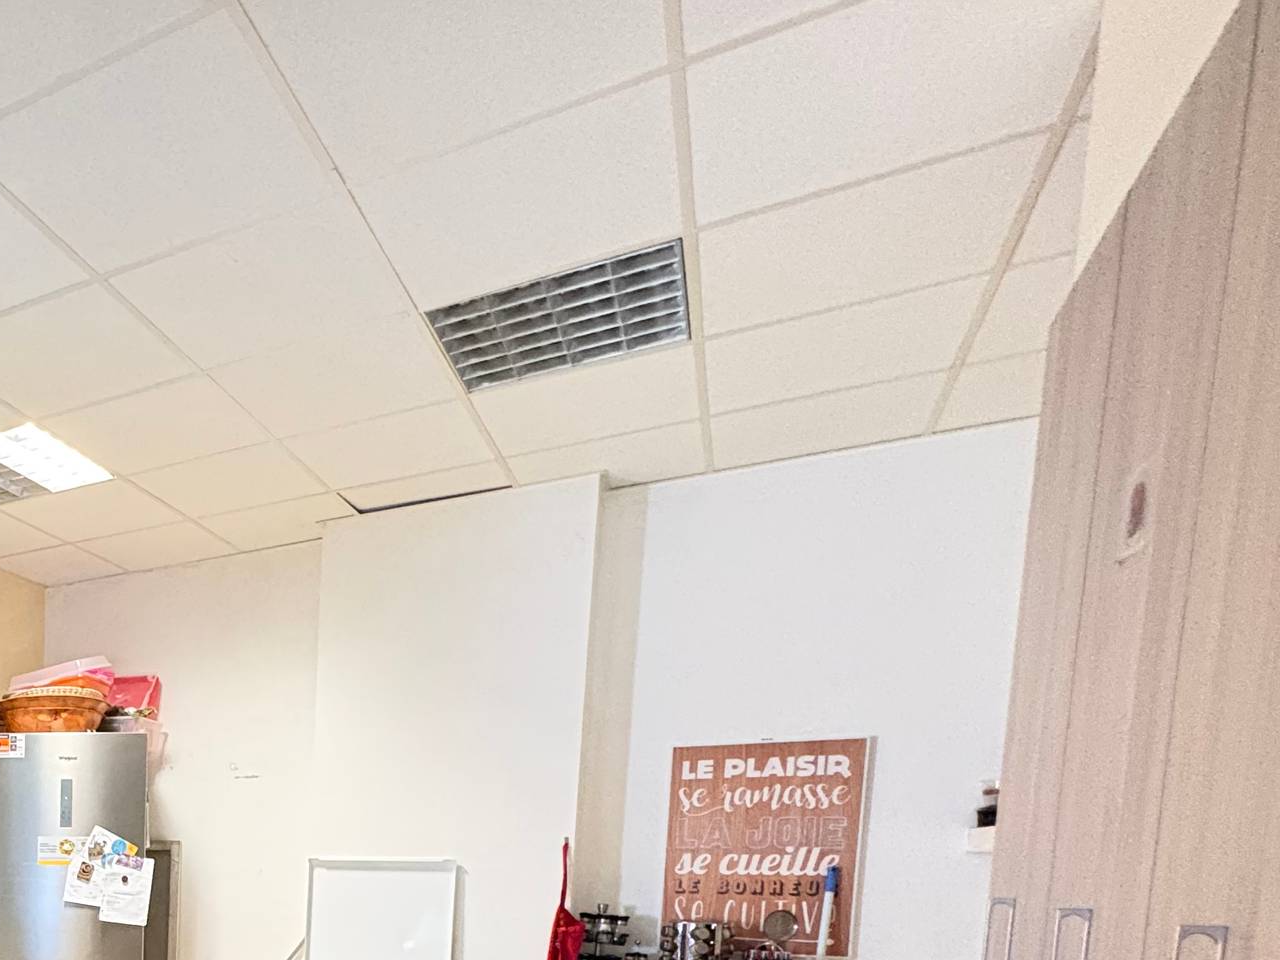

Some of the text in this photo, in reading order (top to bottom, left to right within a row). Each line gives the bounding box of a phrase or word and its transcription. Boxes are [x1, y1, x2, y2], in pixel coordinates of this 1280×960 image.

[681, 755, 852, 780] LE PLAISIR
[678, 783, 852, 815] se ramasse
[675, 816, 848, 849] LA JOIE
[674, 846, 840, 876] se cueille
[674, 879, 838, 897] LE BONHEU
